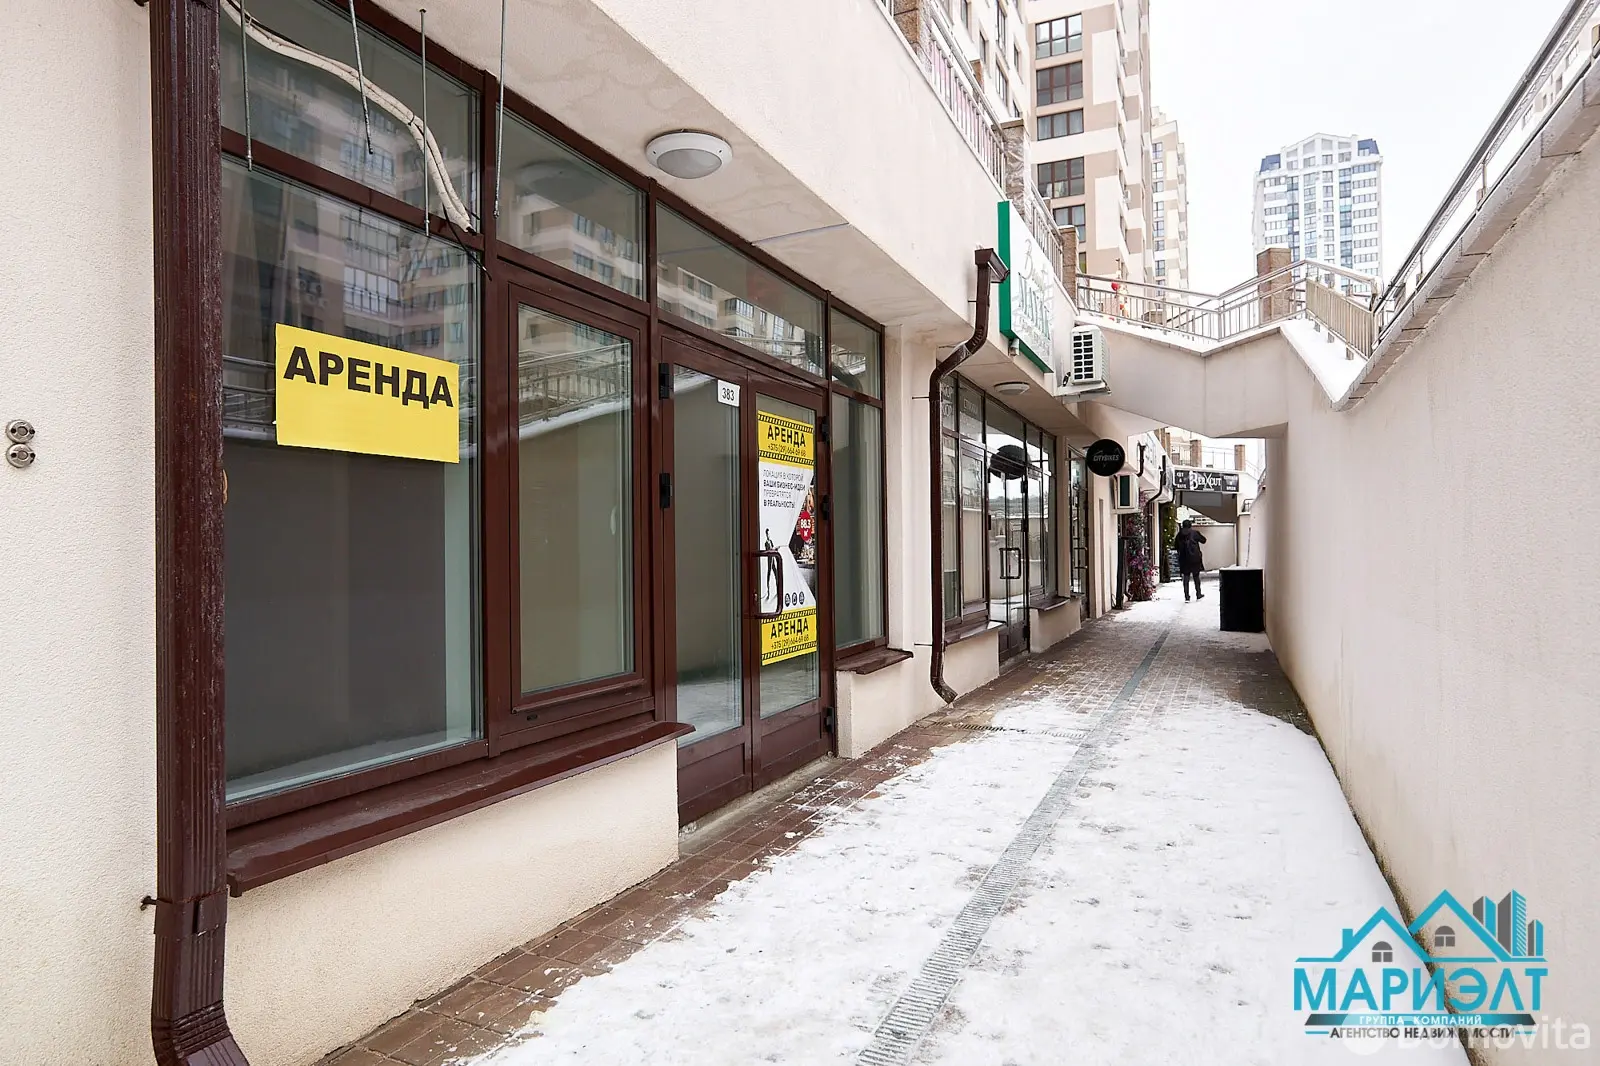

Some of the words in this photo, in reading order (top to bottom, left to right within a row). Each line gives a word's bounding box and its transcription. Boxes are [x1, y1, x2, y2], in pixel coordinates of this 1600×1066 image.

[283, 346, 454, 410] АРЕНДА
[722, 387, 735, 401] 383
[767, 425, 806, 448] АРЕНДА
[770, 617, 808, 639] АРЕНДА
